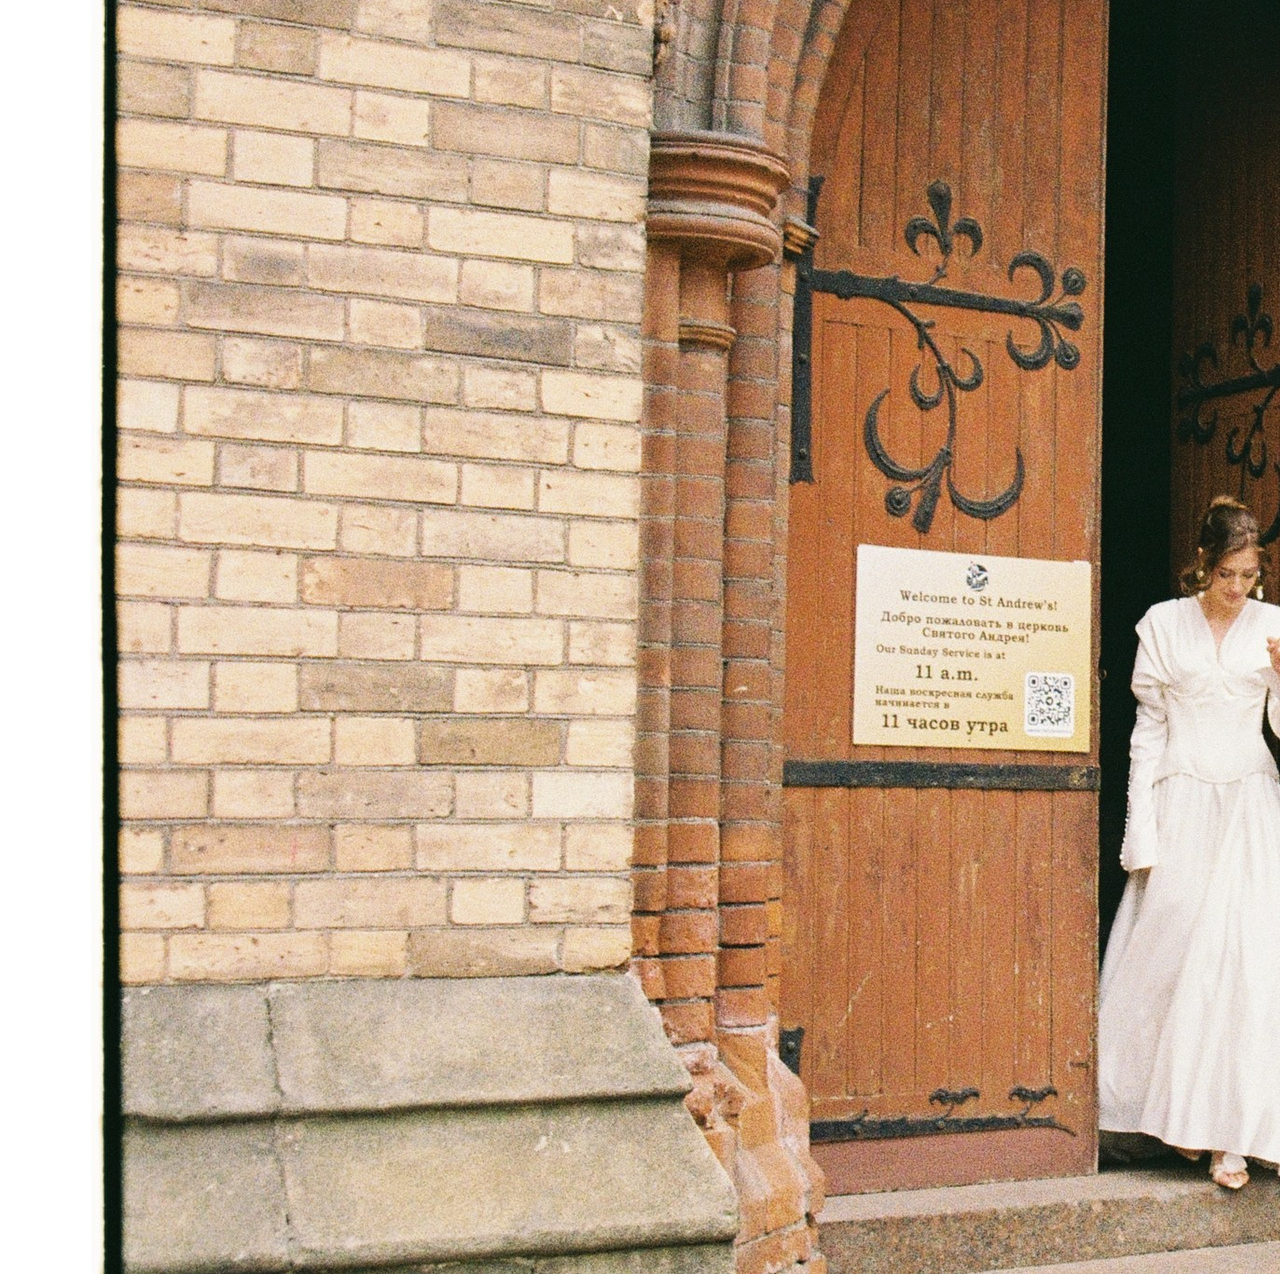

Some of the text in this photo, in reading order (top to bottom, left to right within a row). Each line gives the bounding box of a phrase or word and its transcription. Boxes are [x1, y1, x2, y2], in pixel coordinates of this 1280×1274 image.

[900, 590, 1057, 610] Welcome to St Andrew's!
[881, 611, 921, 625] Добро
[926, 617, 1002, 628] пожаловать
[1018, 622, 1069, 633] церковь
[922, 627, 1030, 644] Святого Андрея!
[876, 644, 895, 654] Our
[899, 645, 938, 657] Sunday
[942, 648, 980, 658] Service
[984, 650, 992, 658] is
[916, 665, 979, 681] 11 a.m.
[876, 685, 1013, 701] Наша воскресная служба
[875, 699, 940, 709] начинается
[881, 714, 1008, 735] 11 часов утра
